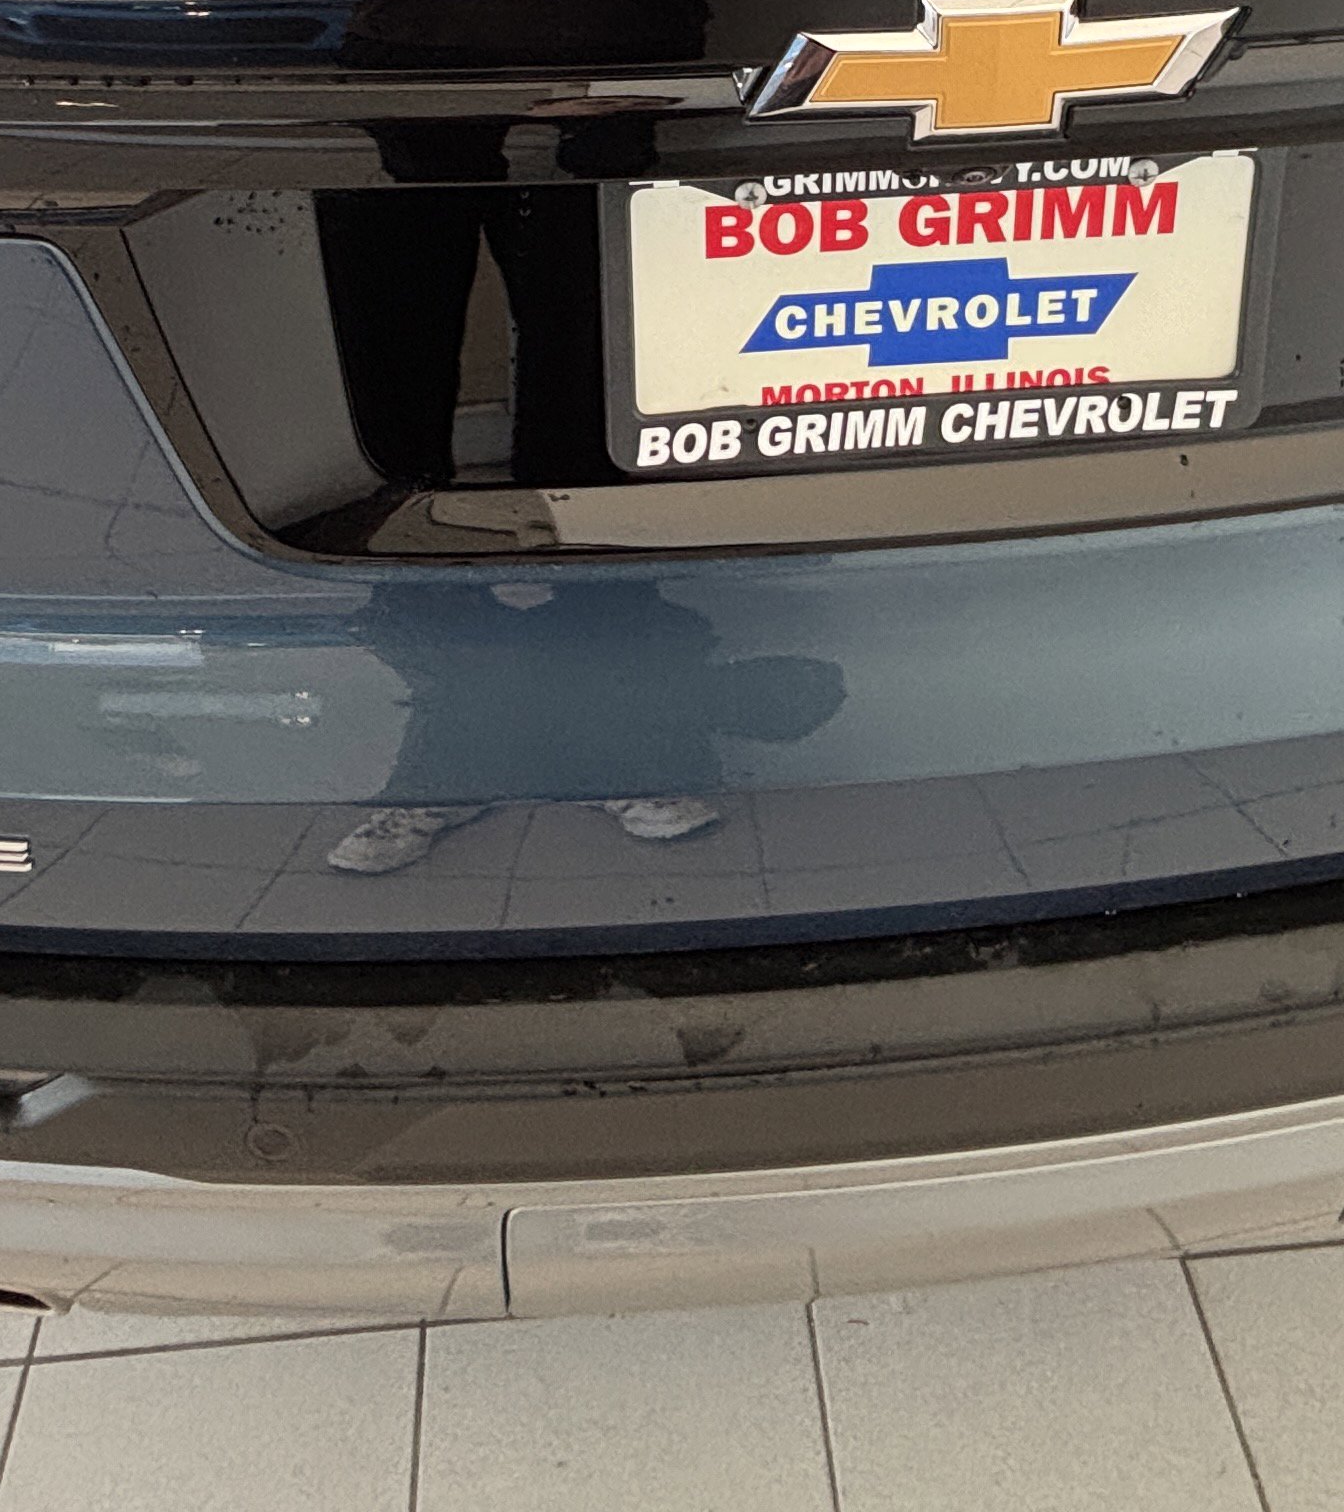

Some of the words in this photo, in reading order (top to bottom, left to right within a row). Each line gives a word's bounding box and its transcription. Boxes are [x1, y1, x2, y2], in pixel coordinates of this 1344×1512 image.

[704, 198, 869, 260] BOB
[898, 181, 1179, 248] GRIMM
[774, 288, 1098, 340] CHEVROLET
[761, 377, 924, 406] MORTON
[636, 419, 742, 467] BOB
[757, 405, 927, 457] GRIMM
[940, 389, 1239, 444] CHEVROLET
